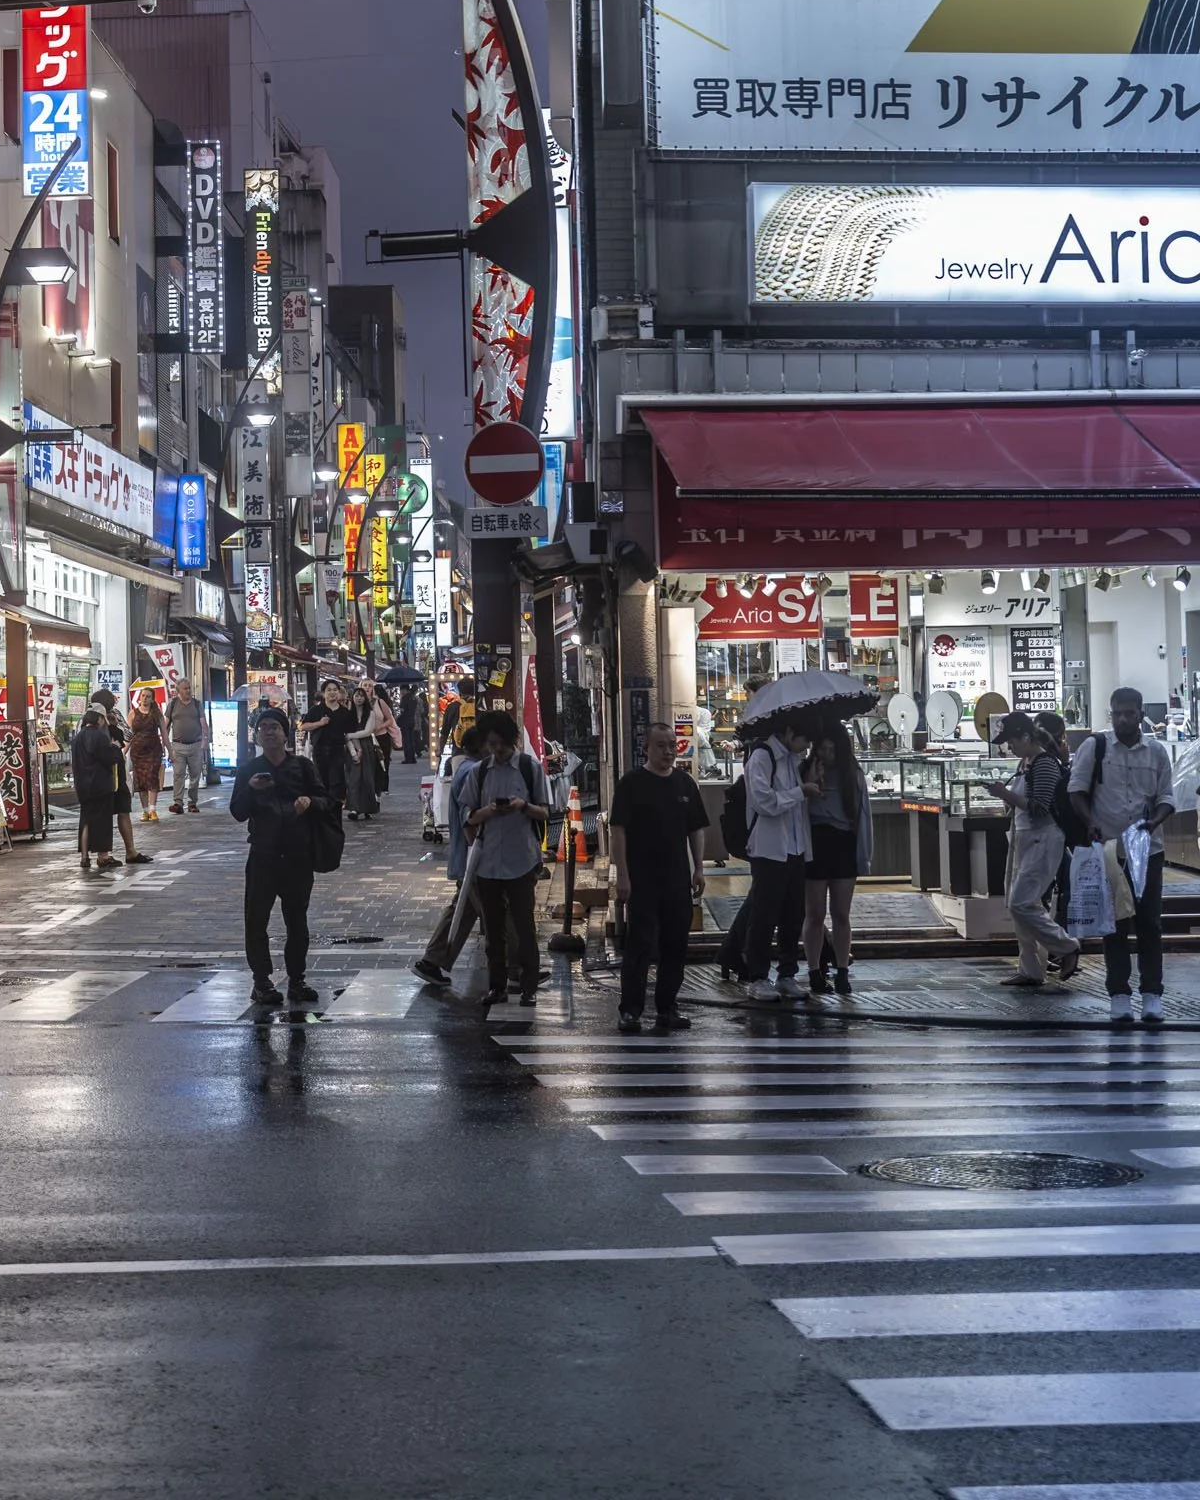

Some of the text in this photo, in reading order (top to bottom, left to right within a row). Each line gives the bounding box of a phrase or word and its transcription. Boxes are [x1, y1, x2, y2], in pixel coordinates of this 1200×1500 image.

[692, 77, 912, 120] 買取専門店
[29, 92, 82, 133] 24
[33, 133, 80, 152] 時間
[40, 150, 67, 162] hou
[26, 166, 86, 194] 営業
[252, 212, 273, 276] Friendly
[934, 258, 1034, 286] Jewelry
[253, 275, 273, 326] Dining
[366, 458, 381, 489] 和牛
[471, 512, 541, 532] 自転車を除く
[732, 607, 773, 624] Aria
[964, 597, 1051, 618] ジュエリー アリア
[1029, 638, 1052, 646] 2273
[1029, 649, 1053, 658] 0885
[98, 670, 110, 683] 24
[1031, 690, 1054, 699] 1933
[1031, 702, 1055, 710] 1998
